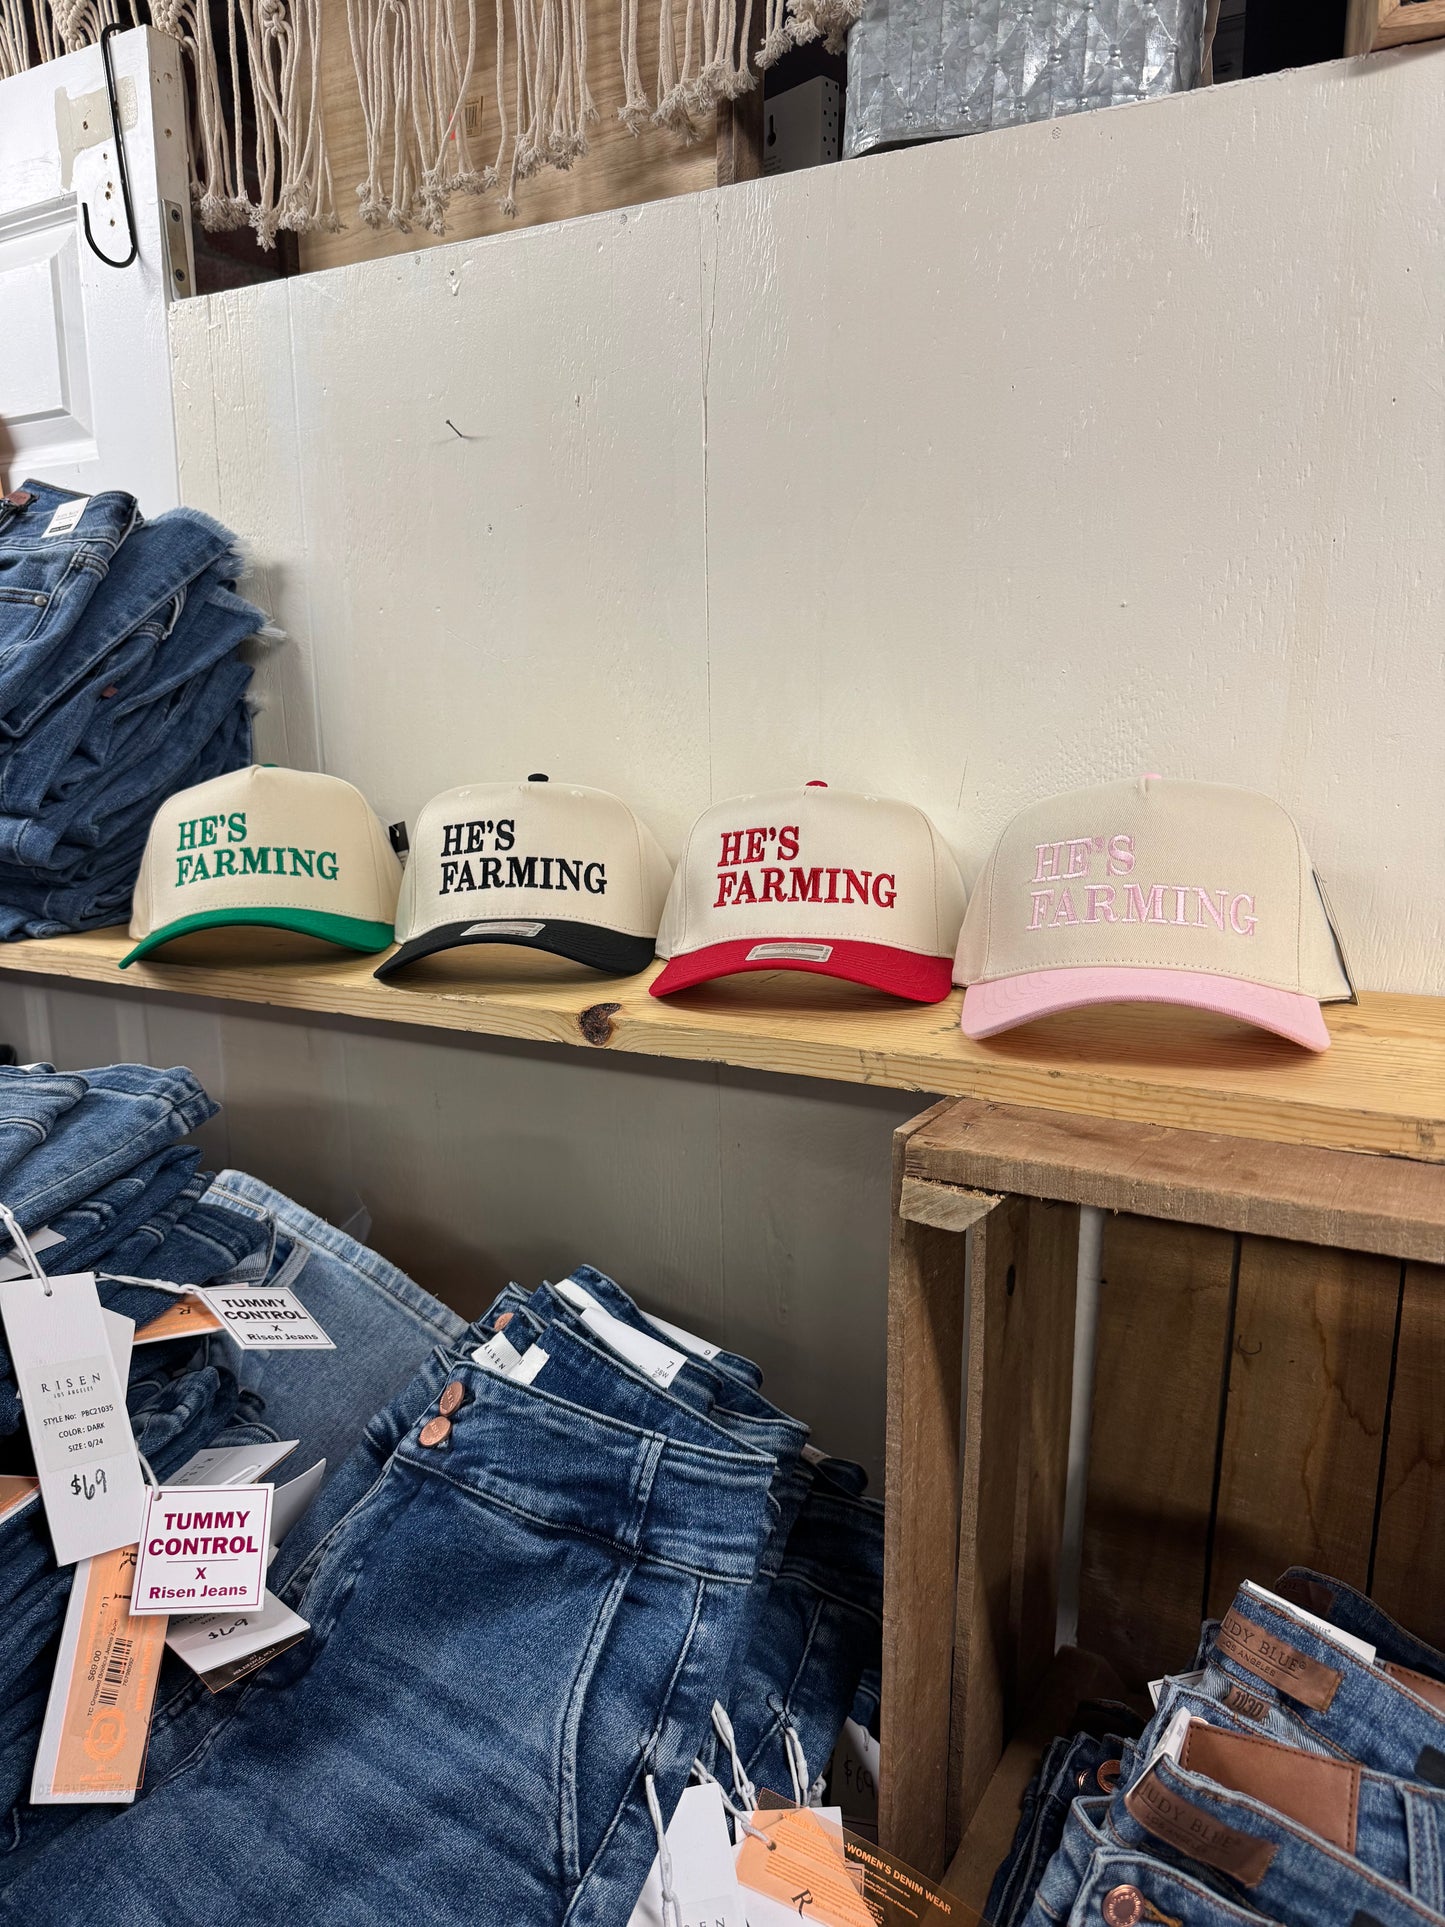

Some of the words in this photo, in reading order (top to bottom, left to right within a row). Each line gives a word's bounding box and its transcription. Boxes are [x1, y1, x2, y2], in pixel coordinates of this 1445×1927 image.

[177, 812, 247, 852] HE'S
[440, 819, 515, 857] HE'S
[717, 825, 800, 867] HE'S
[1031, 834, 1136, 883] HE'S
[175, 846, 339, 888] FARMING
[439, 856, 607, 895] FARMING
[713, 867, 897, 909] FARMING
[1025, 883, 1259, 936] FARMING
[222, 1299, 286, 1308] TUMMY
[224, 1310, 307, 1320] CONTROL
[247, 1333, 283, 1341] Risen
[286, 1333, 319, 1341] Jeans
[41, 1372, 102, 1393] RISEN
[43, 1415, 63, 1427] STYLE
[64, 1413, 77, 1422] No:
[81, 1404, 114, 1418] PBC21035
[87, 1421, 106, 1433] DARK
[88, 1438, 104, 1450] 0/24
[70, 1468, 107, 1500] $69
[164, 1511, 251, 1530] TUMMY
[148, 1536, 258, 1556] CONTROL
[149, 1586, 196, 1599] Risen
[200, 1585, 248, 1598] Jeans
[208, 1617, 249, 1640] $69
[88, 1649, 102, 1681] $69.00
[1238, 1650, 1276, 1677] ANGELES
[892, 1869, 924, 1895] DENIM
[925, 1889, 952, 1915] WEAR
